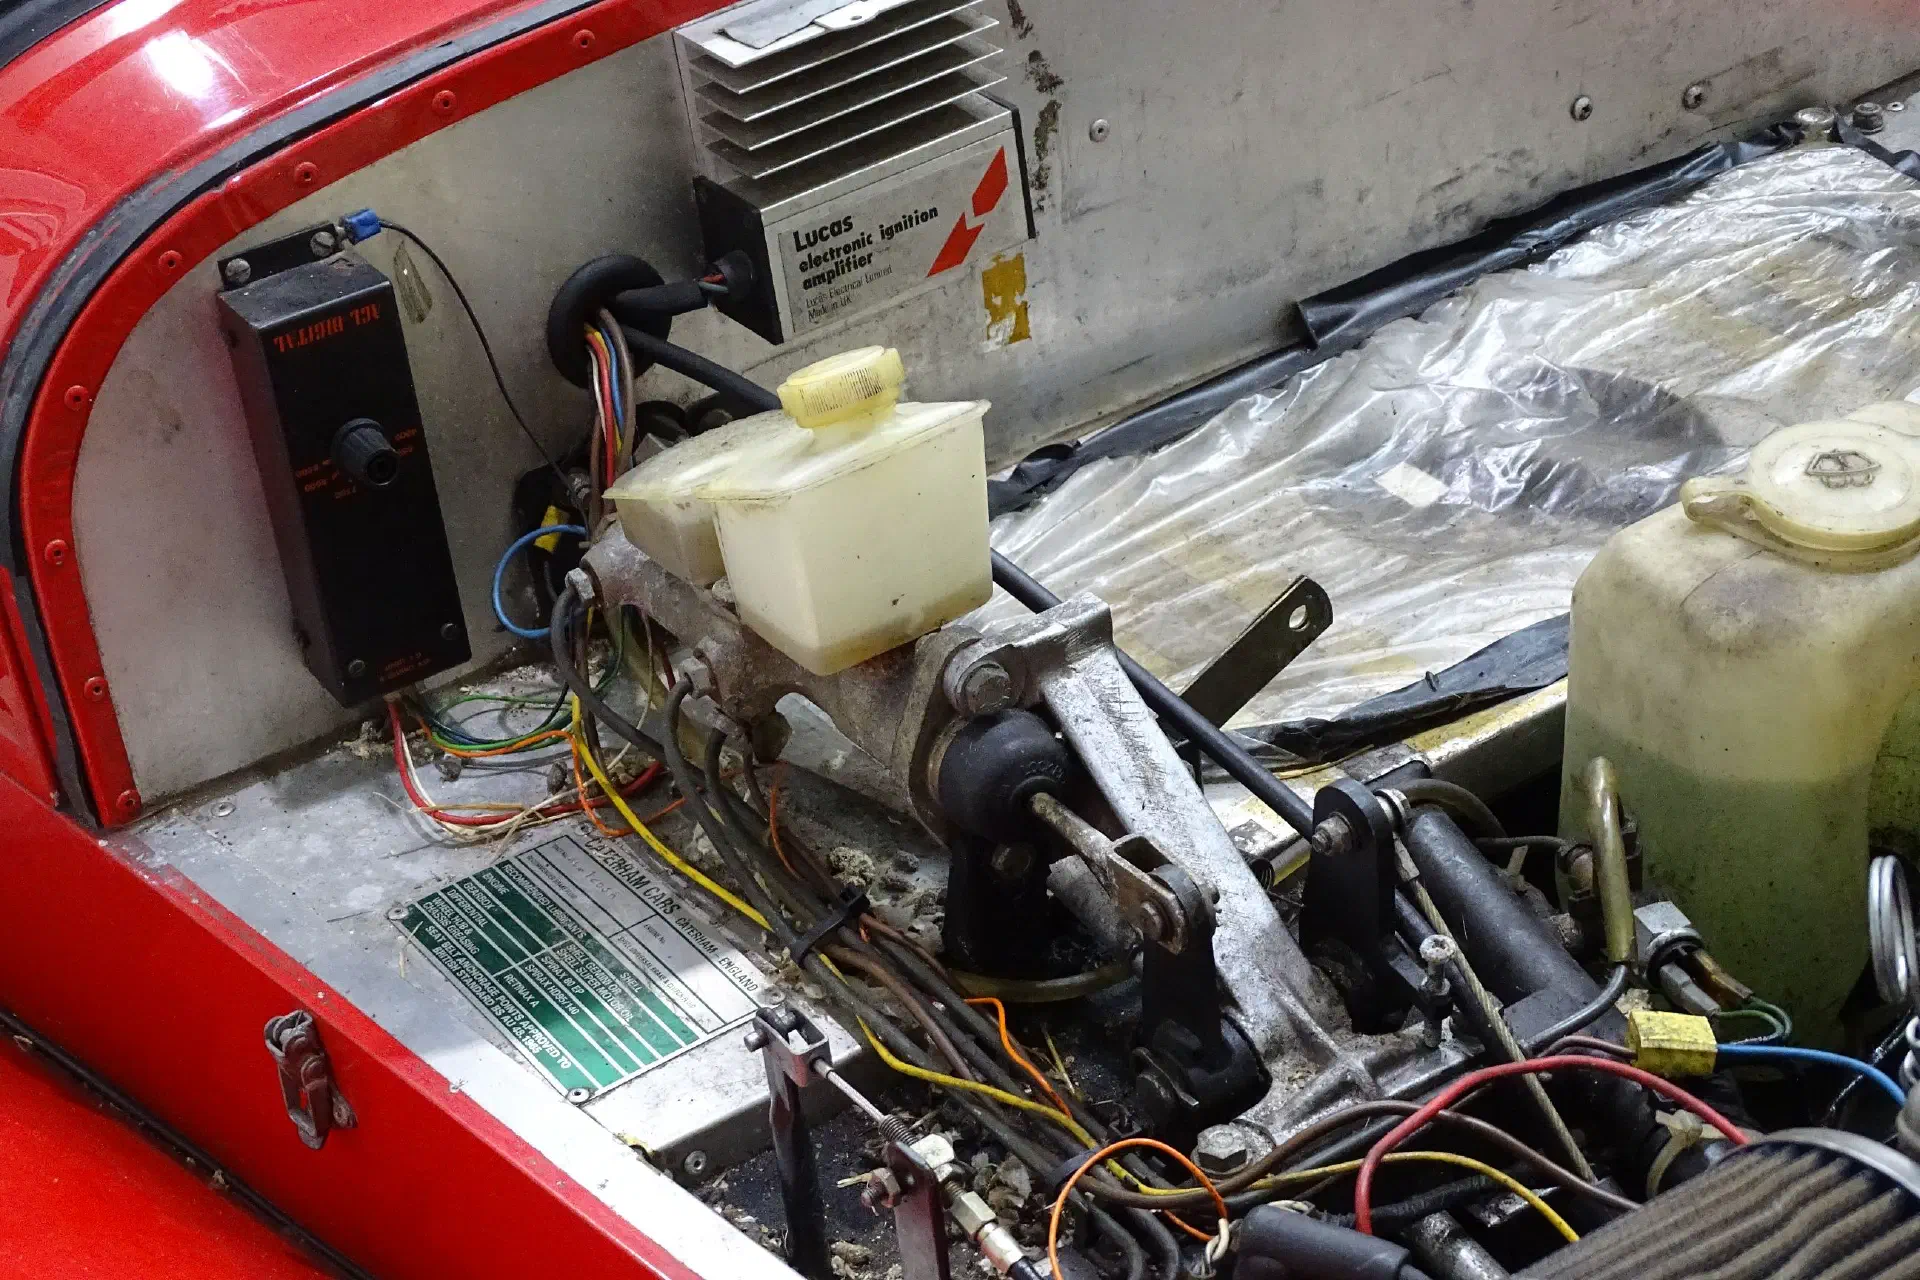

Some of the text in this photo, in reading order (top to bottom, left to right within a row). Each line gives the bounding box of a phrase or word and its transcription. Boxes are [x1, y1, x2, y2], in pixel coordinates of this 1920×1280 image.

[793, 215, 854, 252] Lucas
[799, 207, 939, 273] electronic ignition
[802, 251, 873, 290] amplifier
[806, 290, 829, 308] Lucas
[828, 277, 863, 300] Electrical
[273, 317, 344, 352] DIGITAL
[463, 882, 494, 909] GEARBOX
[482, 873, 508, 894] ENGINE
[431, 897, 473, 935] WHEEL HUB &
[447, 890, 488, 926] DIFFERENTIAL
[502, 864, 643, 991] RECOMMENDED LUBRICANTS SHELL
[583, 837, 651, 888] CATERHAM
[642, 886, 681, 914] CARS
[674, 917, 718, 953] CATERHAM
[717, 957, 759, 991] ENGLAND
[423, 902, 480, 954] CHASSIS GREASING
[432, 946, 460, 971] BRITISH
[455, 970, 495, 1005] STANDARD
[490, 1005, 504, 1015] BS
[500, 1015, 515, 1026] AU
[525, 964, 550, 986] SPIRAX
[540, 956, 566, 978] SPIRAX
[570, 984, 583, 995] EP
[556, 949, 635, 1020] SHELL SUPER MOTOR OIL
[565, 944, 622, 994] SHELL GEMINI OR
[425, 926, 572, 1069] SEAT BELT ANCHORAGE POINTS APPROVED TO
[503, 974, 539, 1007] RETINAX A
